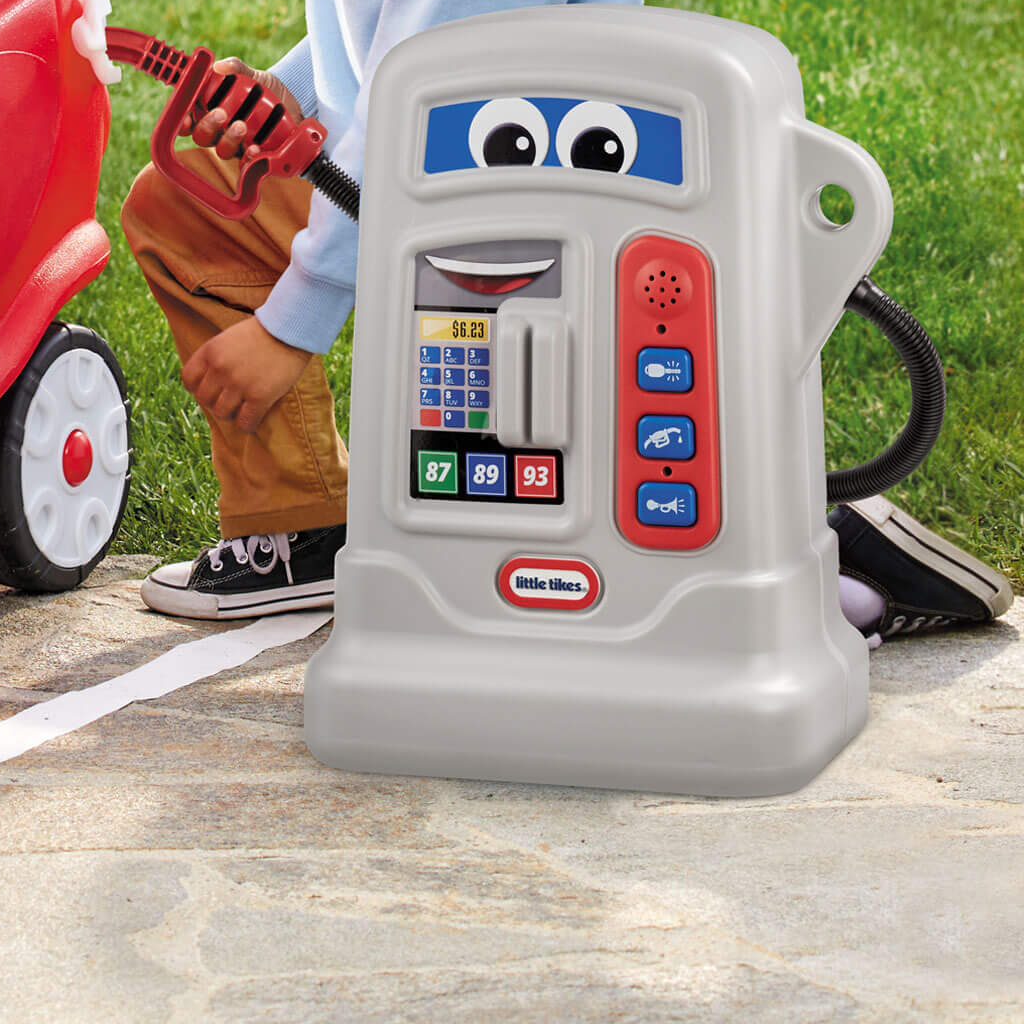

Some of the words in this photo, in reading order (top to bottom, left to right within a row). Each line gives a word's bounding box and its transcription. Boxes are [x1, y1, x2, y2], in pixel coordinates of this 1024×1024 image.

[452, 319, 484, 338] $6.23
[421, 347, 427, 356] 1
[445, 348, 452, 357] 2
[469, 349, 476, 358] 3
[421, 368, 428, 377] 4
[445, 369, 452, 378] 5
[469, 370, 476, 379] 6
[421, 389, 428, 398] 7
[445, 390, 452, 399] 8
[469, 391, 476, 400] 9
[445, 411, 452, 420] 0
[425, 461, 452, 482] 87
[473, 463, 499, 485] 89
[523, 465, 549, 486] 93
[516, 576, 546, 590] little
[548, 577, 582, 592] tikes
